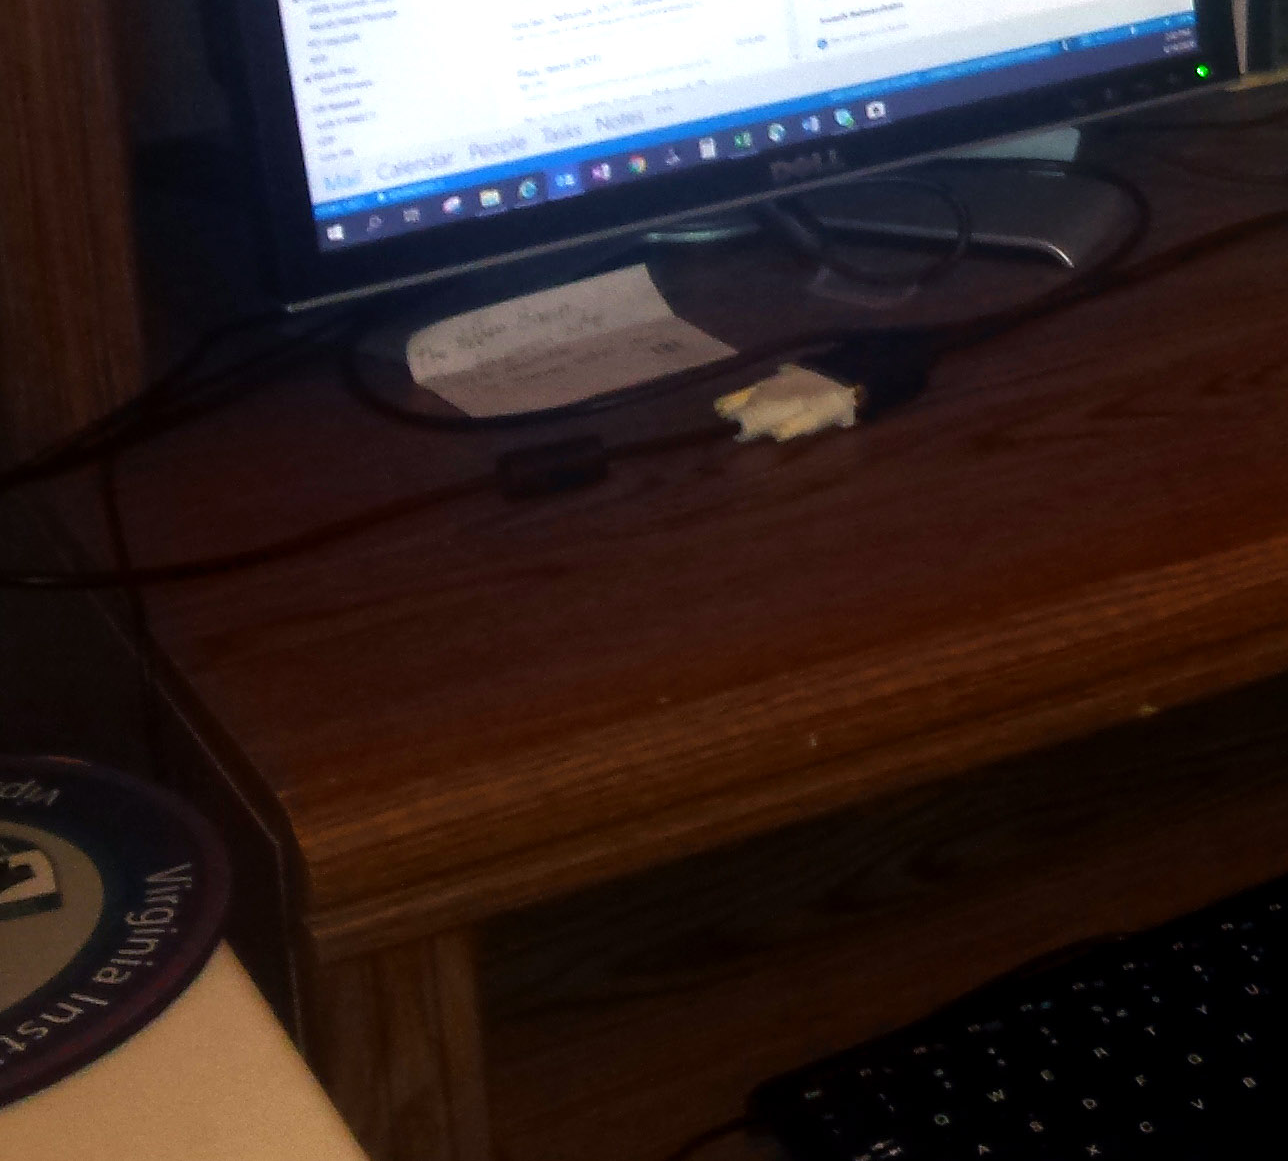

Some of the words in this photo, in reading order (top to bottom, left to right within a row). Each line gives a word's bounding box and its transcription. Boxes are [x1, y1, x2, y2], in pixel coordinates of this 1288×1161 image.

[376, 151, 454, 182] Calendar
[468, 136, 528, 161] People
[594, 109, 646, 133] Notes
[93, 860, 194, 987] Virginia
[0, 992, 109, 1066] Inst
